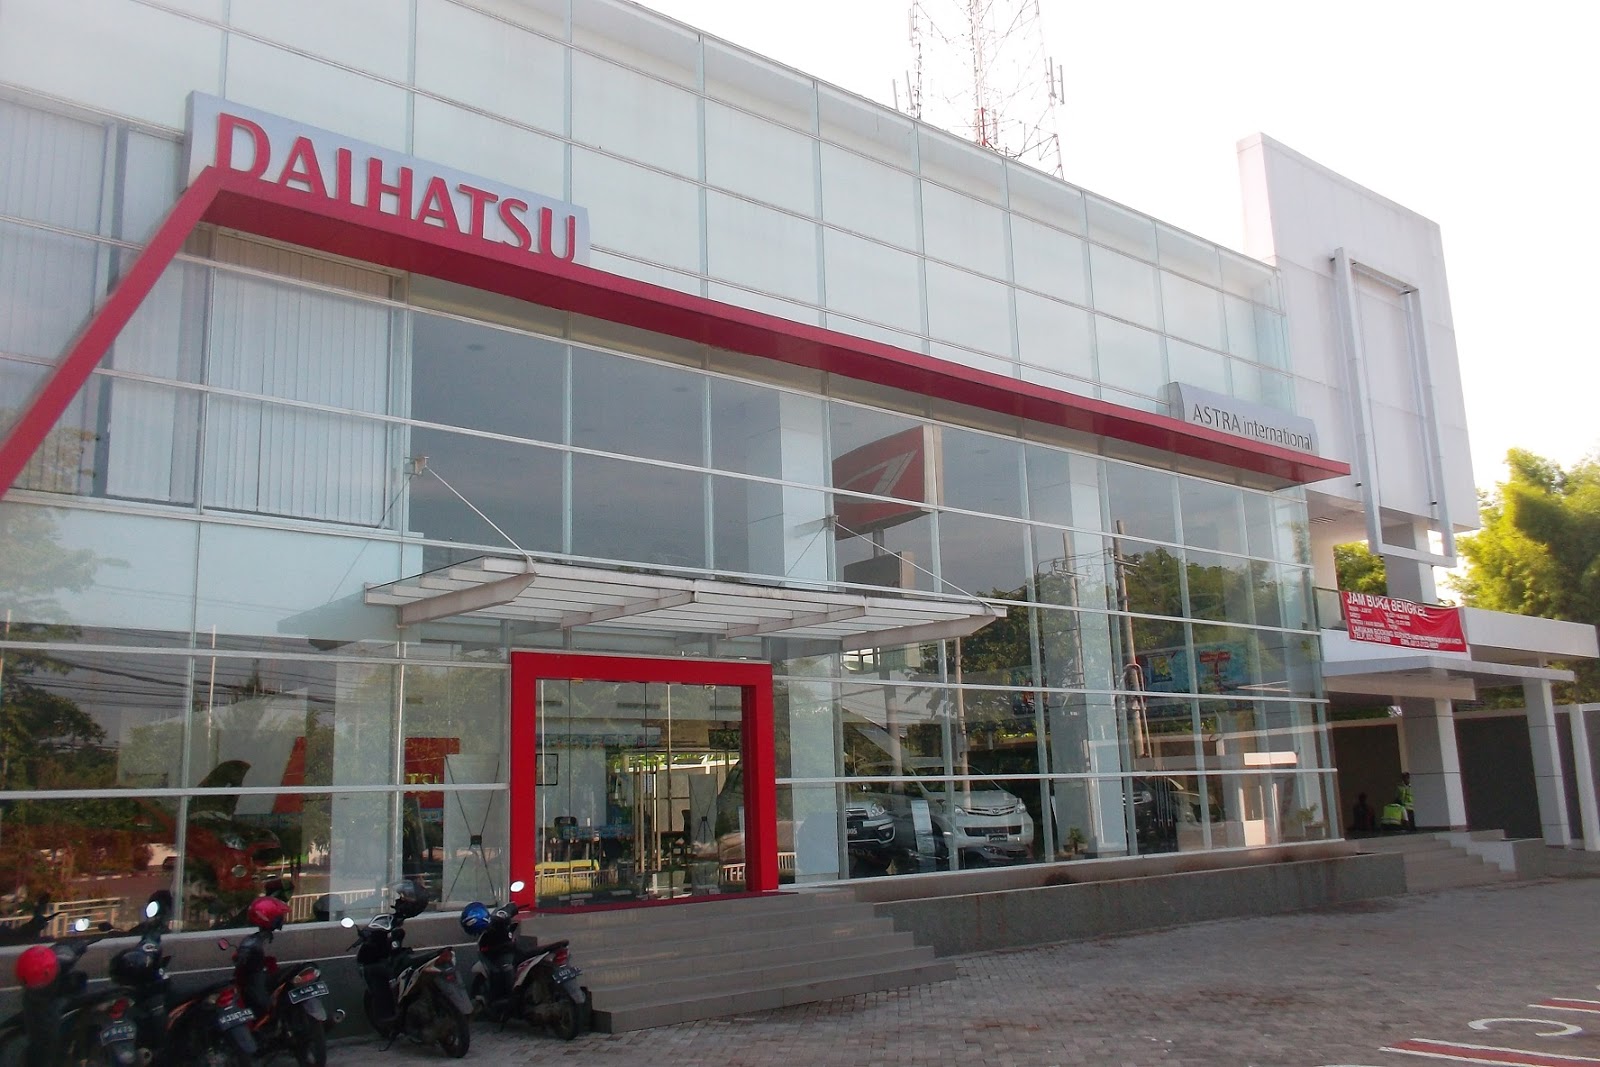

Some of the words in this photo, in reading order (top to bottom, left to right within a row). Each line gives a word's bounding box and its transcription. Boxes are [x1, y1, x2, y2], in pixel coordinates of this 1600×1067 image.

[216, 112, 576, 263] DAIHATSU
[1193, 403, 1241, 433] ASTRA
[1242, 415, 1313, 451] international
[1347, 591, 1366, 606] JAM
[1366, 594, 1391, 612] BUKA
[1390, 599, 1429, 617] BENGKEL
